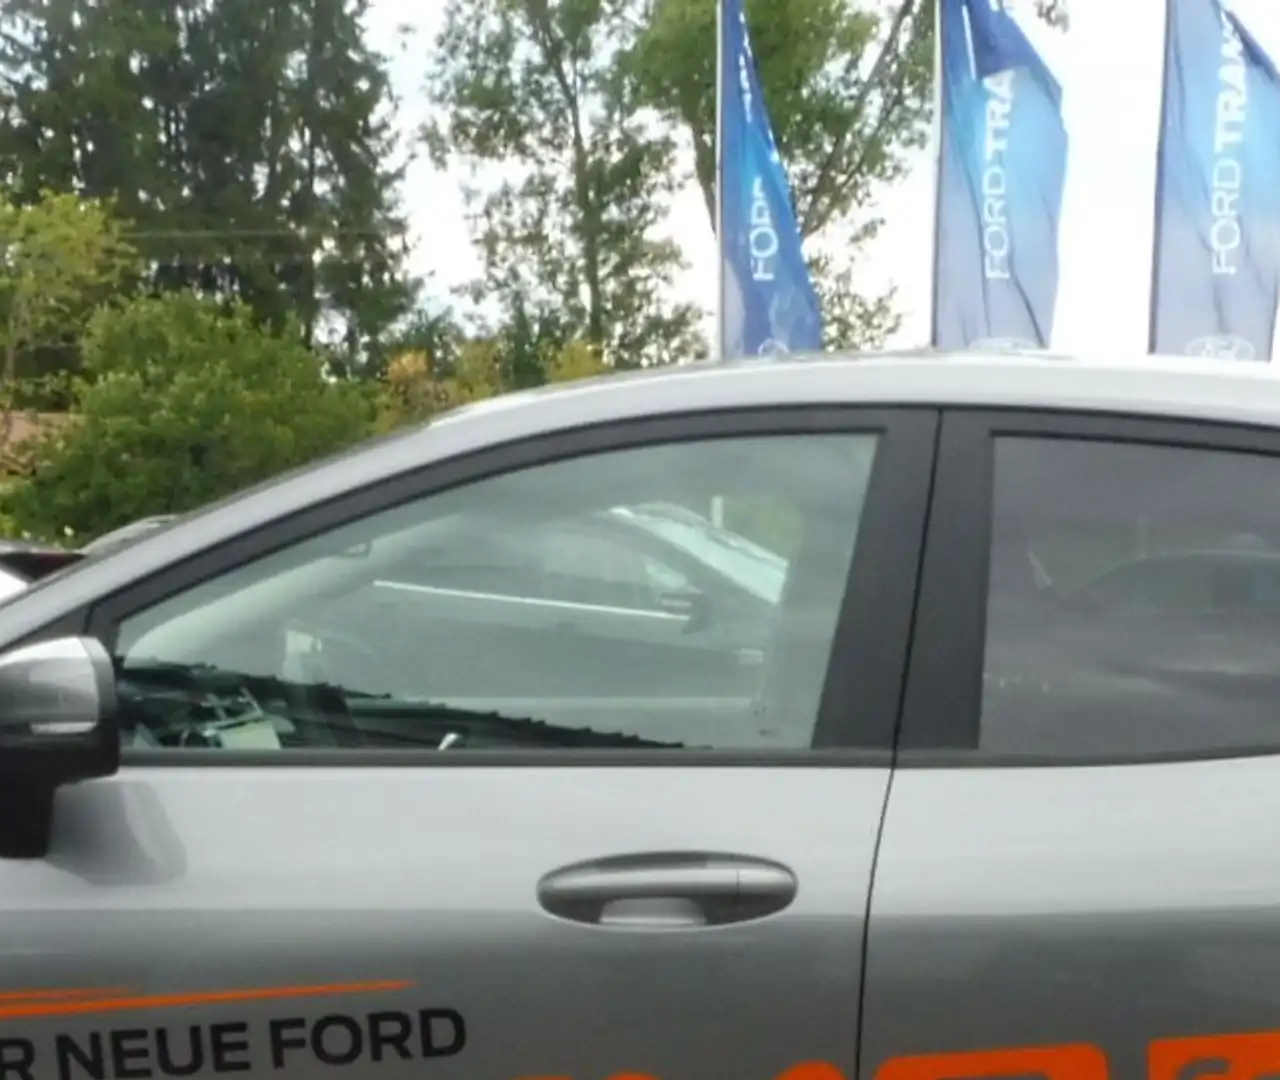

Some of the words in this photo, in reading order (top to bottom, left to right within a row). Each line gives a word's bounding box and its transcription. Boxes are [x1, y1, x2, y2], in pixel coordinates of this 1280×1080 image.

[982, 167, 1010, 280] FORD
[1210, 158, 1242, 275] FORD
[269, 1007, 467, 1070] FORD
